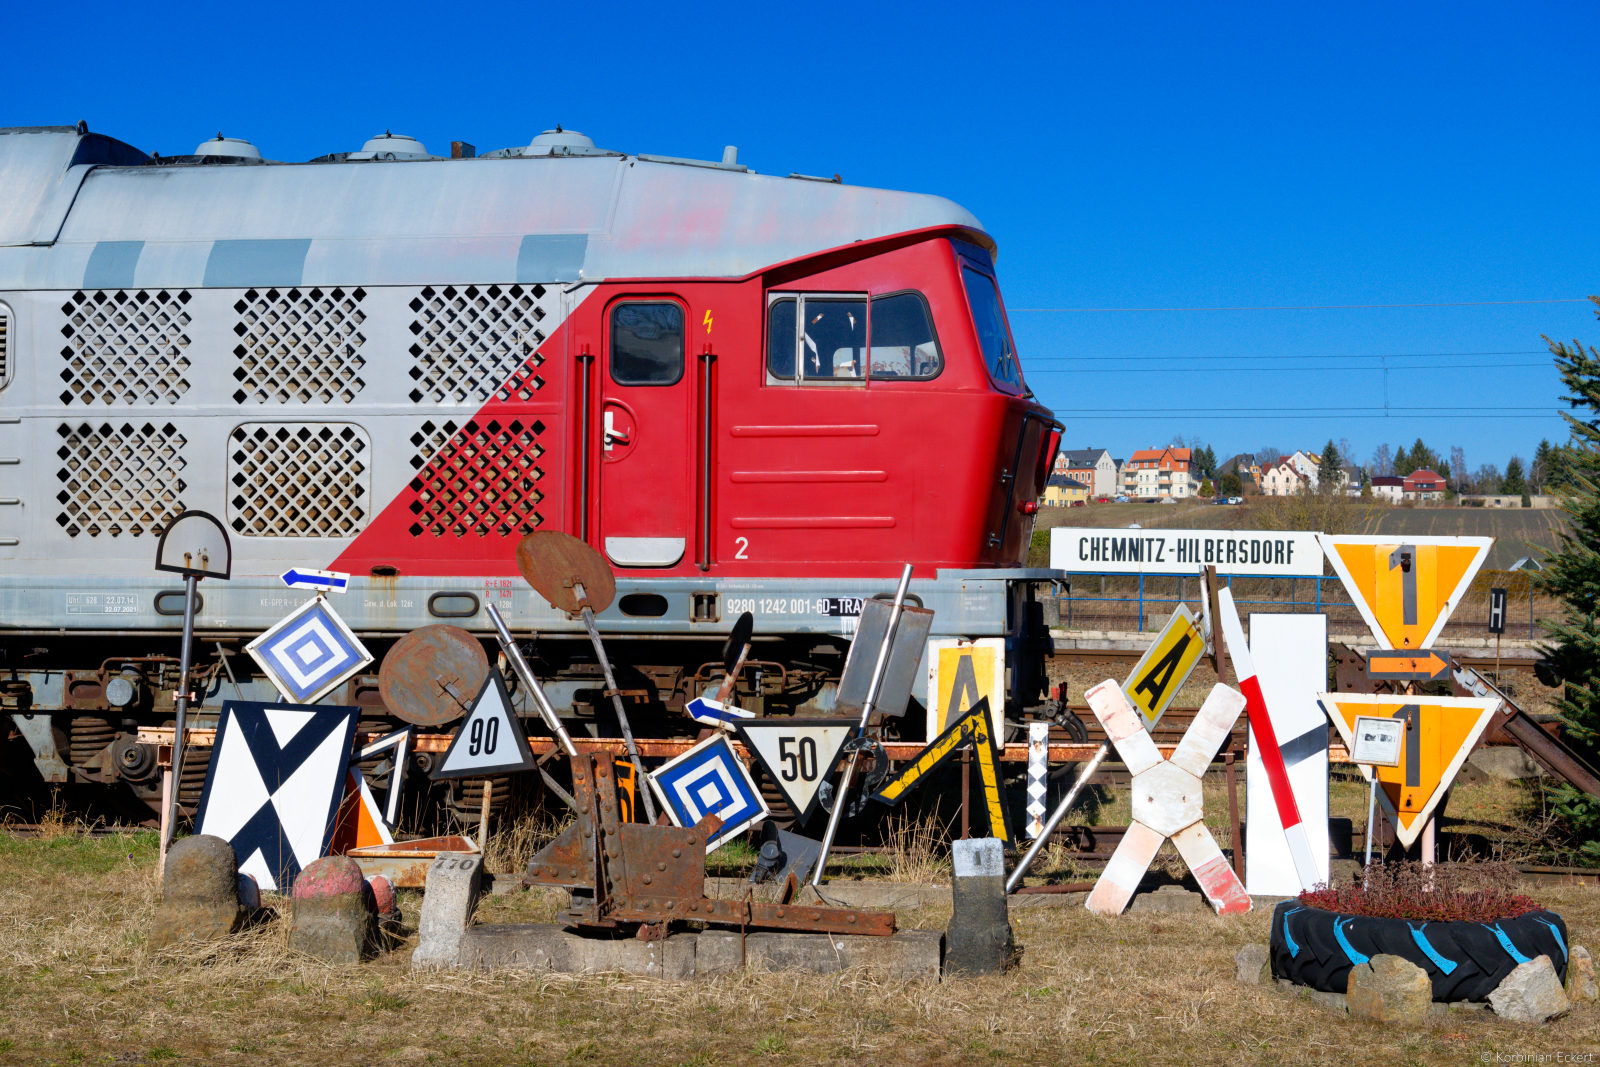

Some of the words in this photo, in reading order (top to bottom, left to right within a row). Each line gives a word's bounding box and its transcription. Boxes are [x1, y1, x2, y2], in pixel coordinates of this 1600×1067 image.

[735, 537, 748, 560] 2
[1079, 537, 1294, 564] CHEMNITZ-HILBERSDORF
[728, 598, 755, 614] 9280
[759, 598, 786, 614] 1242
[1389, 545, 1417, 625] 1
[1491, 592, 1502, 628] H
[943, 655, 980, 732] A
[1134, 633, 1191, 712] A
[469, 716, 499, 756] 90
[1393, 704, 1420, 786] 1
[779, 737, 818, 782] 50
